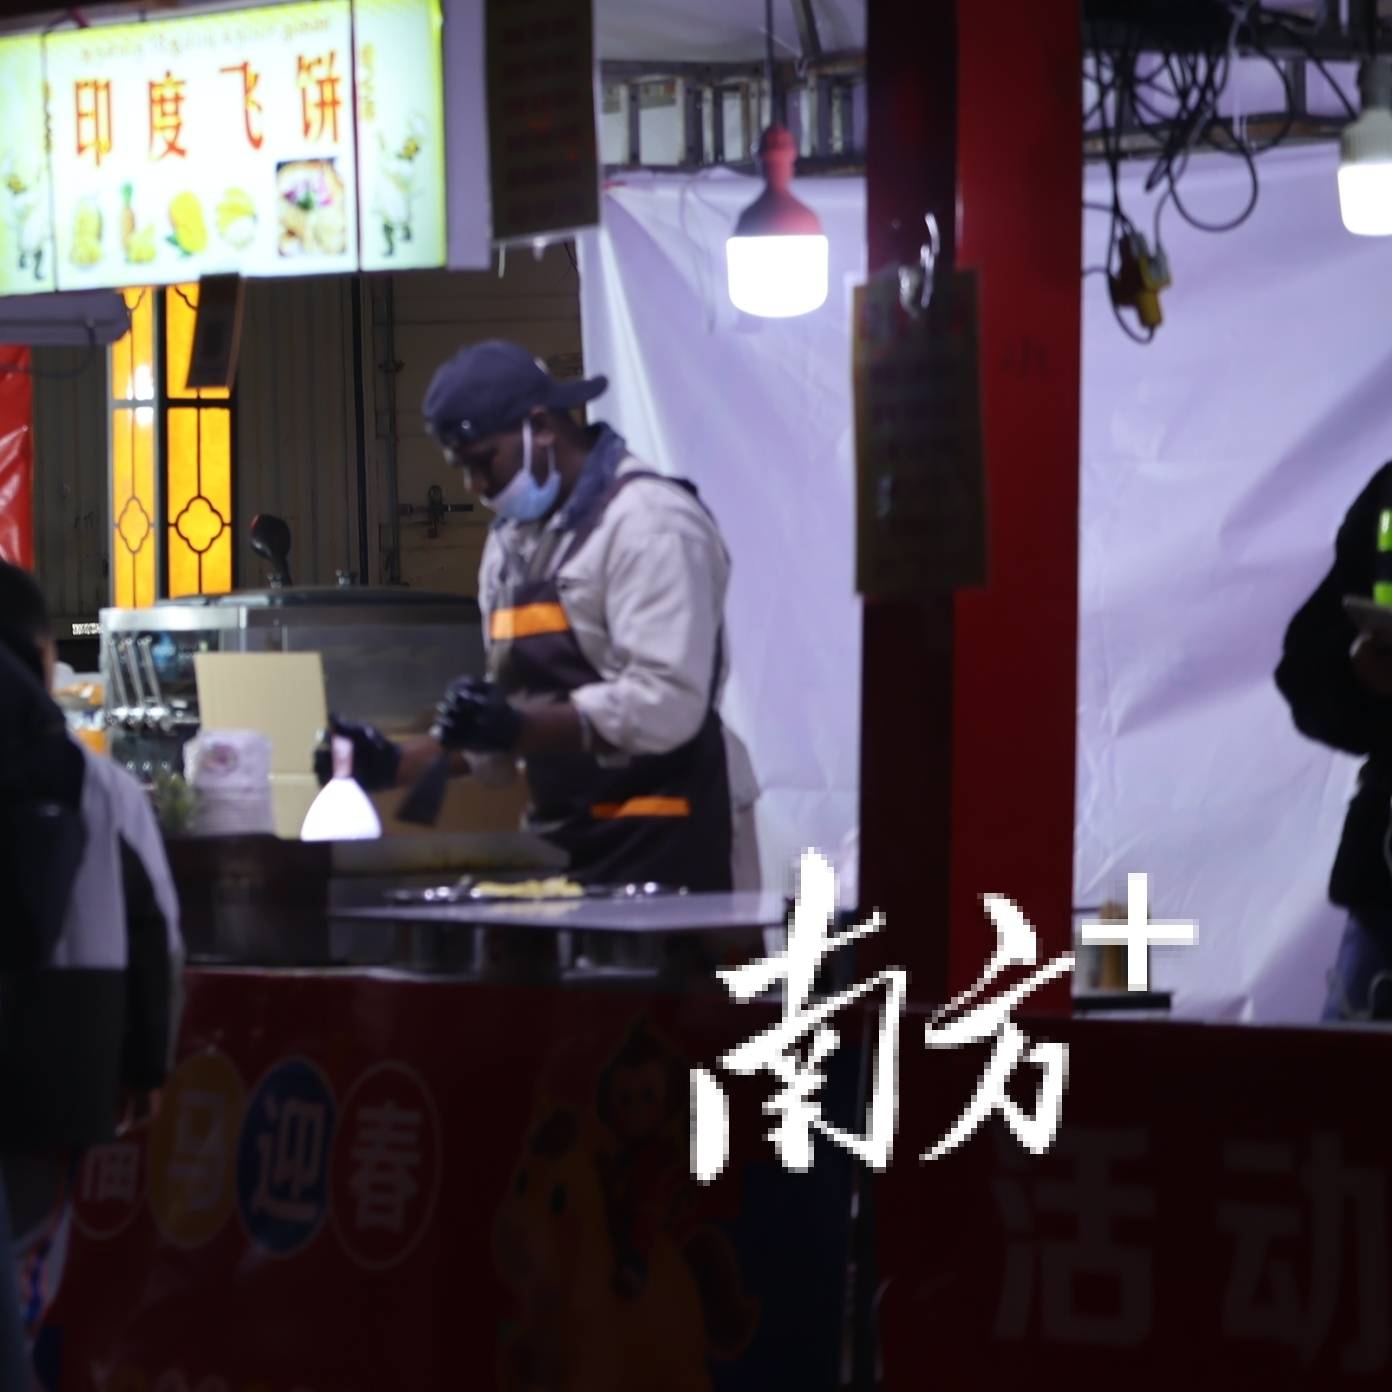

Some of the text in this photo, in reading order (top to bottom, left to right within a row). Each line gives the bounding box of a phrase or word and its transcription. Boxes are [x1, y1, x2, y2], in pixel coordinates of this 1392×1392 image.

[73, 48, 341, 167] 印度飞饼
[991, 1123, 1390, 1378] 活动
